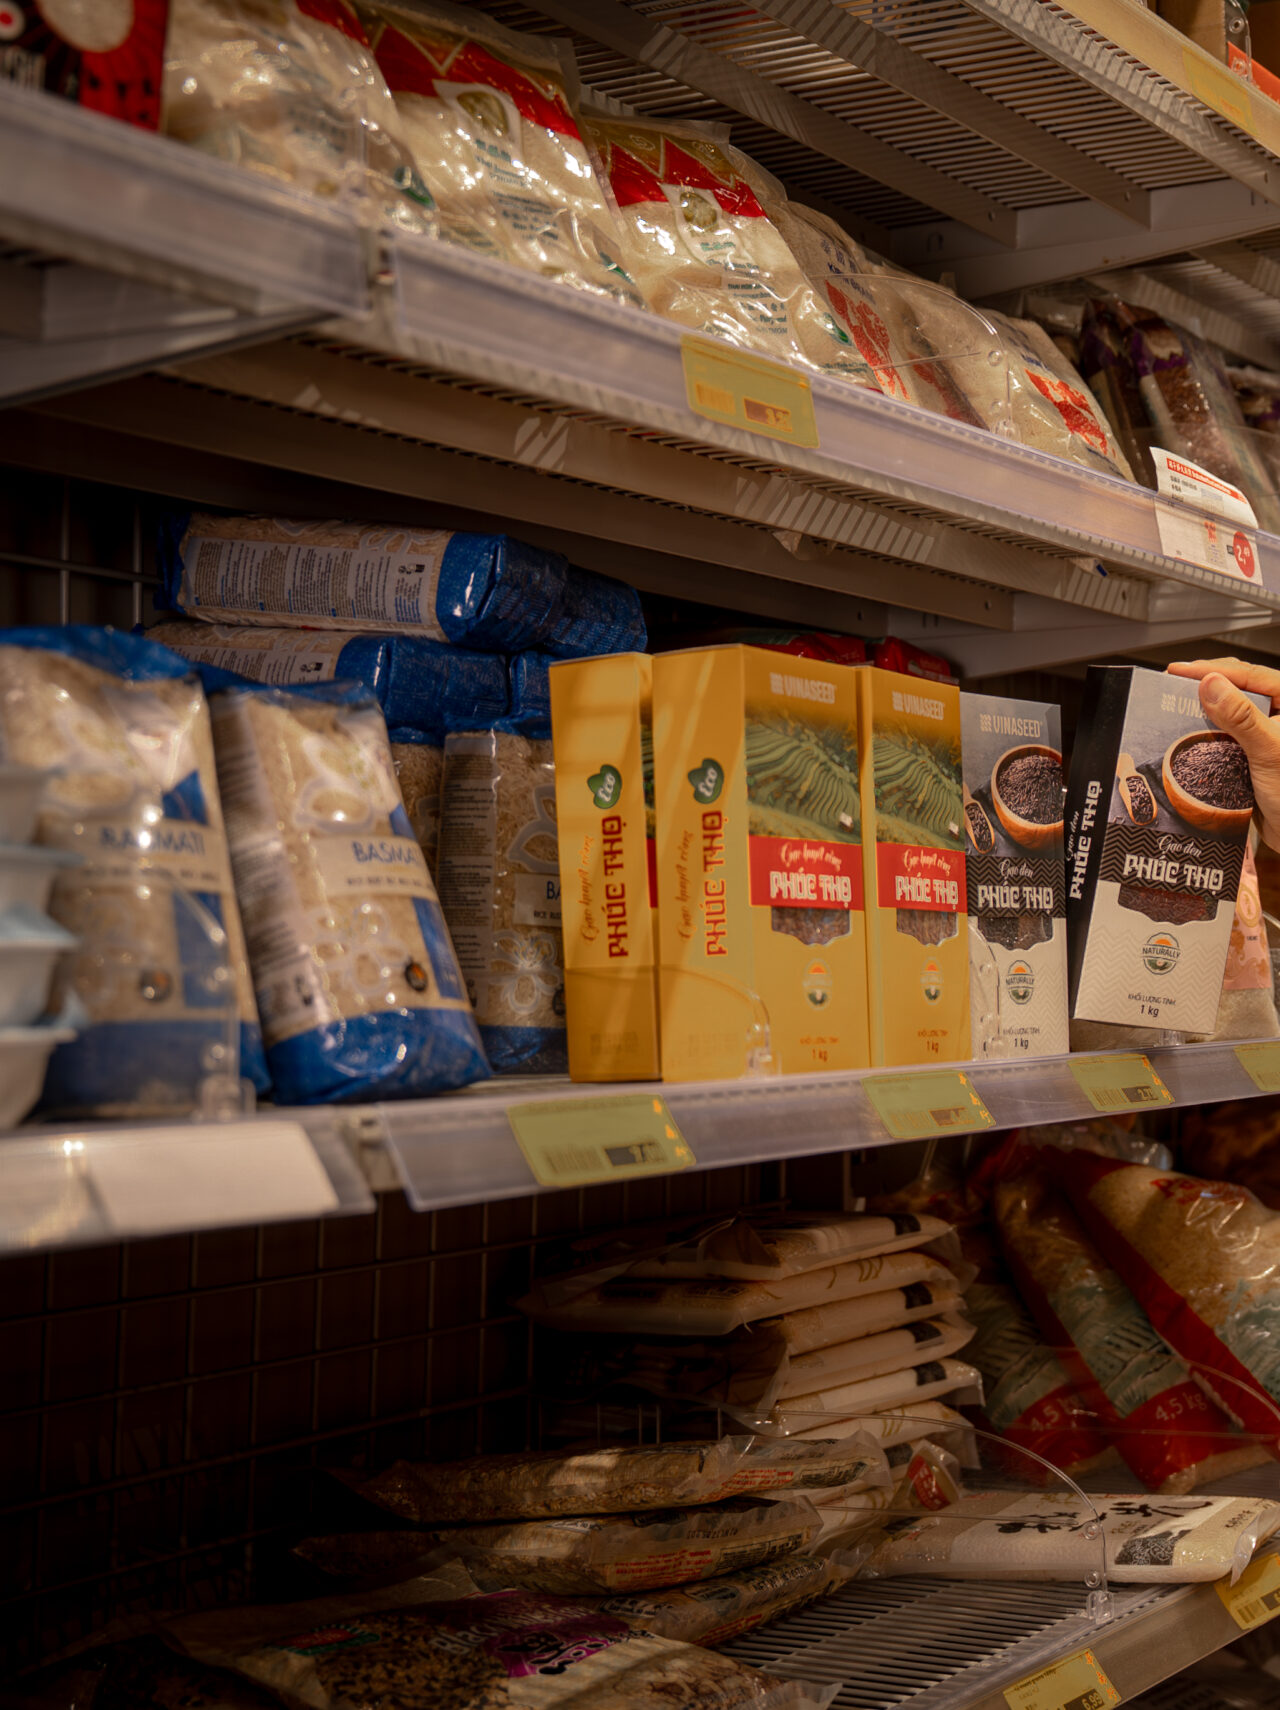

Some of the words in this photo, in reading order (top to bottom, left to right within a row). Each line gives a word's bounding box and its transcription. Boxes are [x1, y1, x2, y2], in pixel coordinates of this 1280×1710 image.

[993, 716, 1041, 738] VINASEED
[602, 815, 627, 876] THỌ
[702, 811, 729, 872] THỌ
[1069, 836, 1092, 900] PHÚC
[1081, 781, 1103, 832] THỌ
[769, 867, 818, 900] PHÚC
[819, 873, 852, 908] THỌ
[895, 872, 931, 903] PHÚC
[932, 879, 959, 910] THỌ
[1123, 854, 1180, 884] PHÚC
[1183, 863, 1224, 896] THỌ
[977, 878, 1020, 909] PHÚC
[1022, 886, 1054, 914] THỌ
[601, 882, 629, 958] PHÚC
[699, 880, 728, 956] PHÚC
[1142, 947, 1181, 959] NATURALLY
[1005, 976, 1035, 986] NATURALLY
[1141, 1004, 1145, 1014] 1
[1148, 1006, 1159, 1017] kg
[1014, 1038, 1018, 1047] 1
[1020, 1038, 1029, 1049] kg
[1156, 1397, 1183, 1422] 4,5
